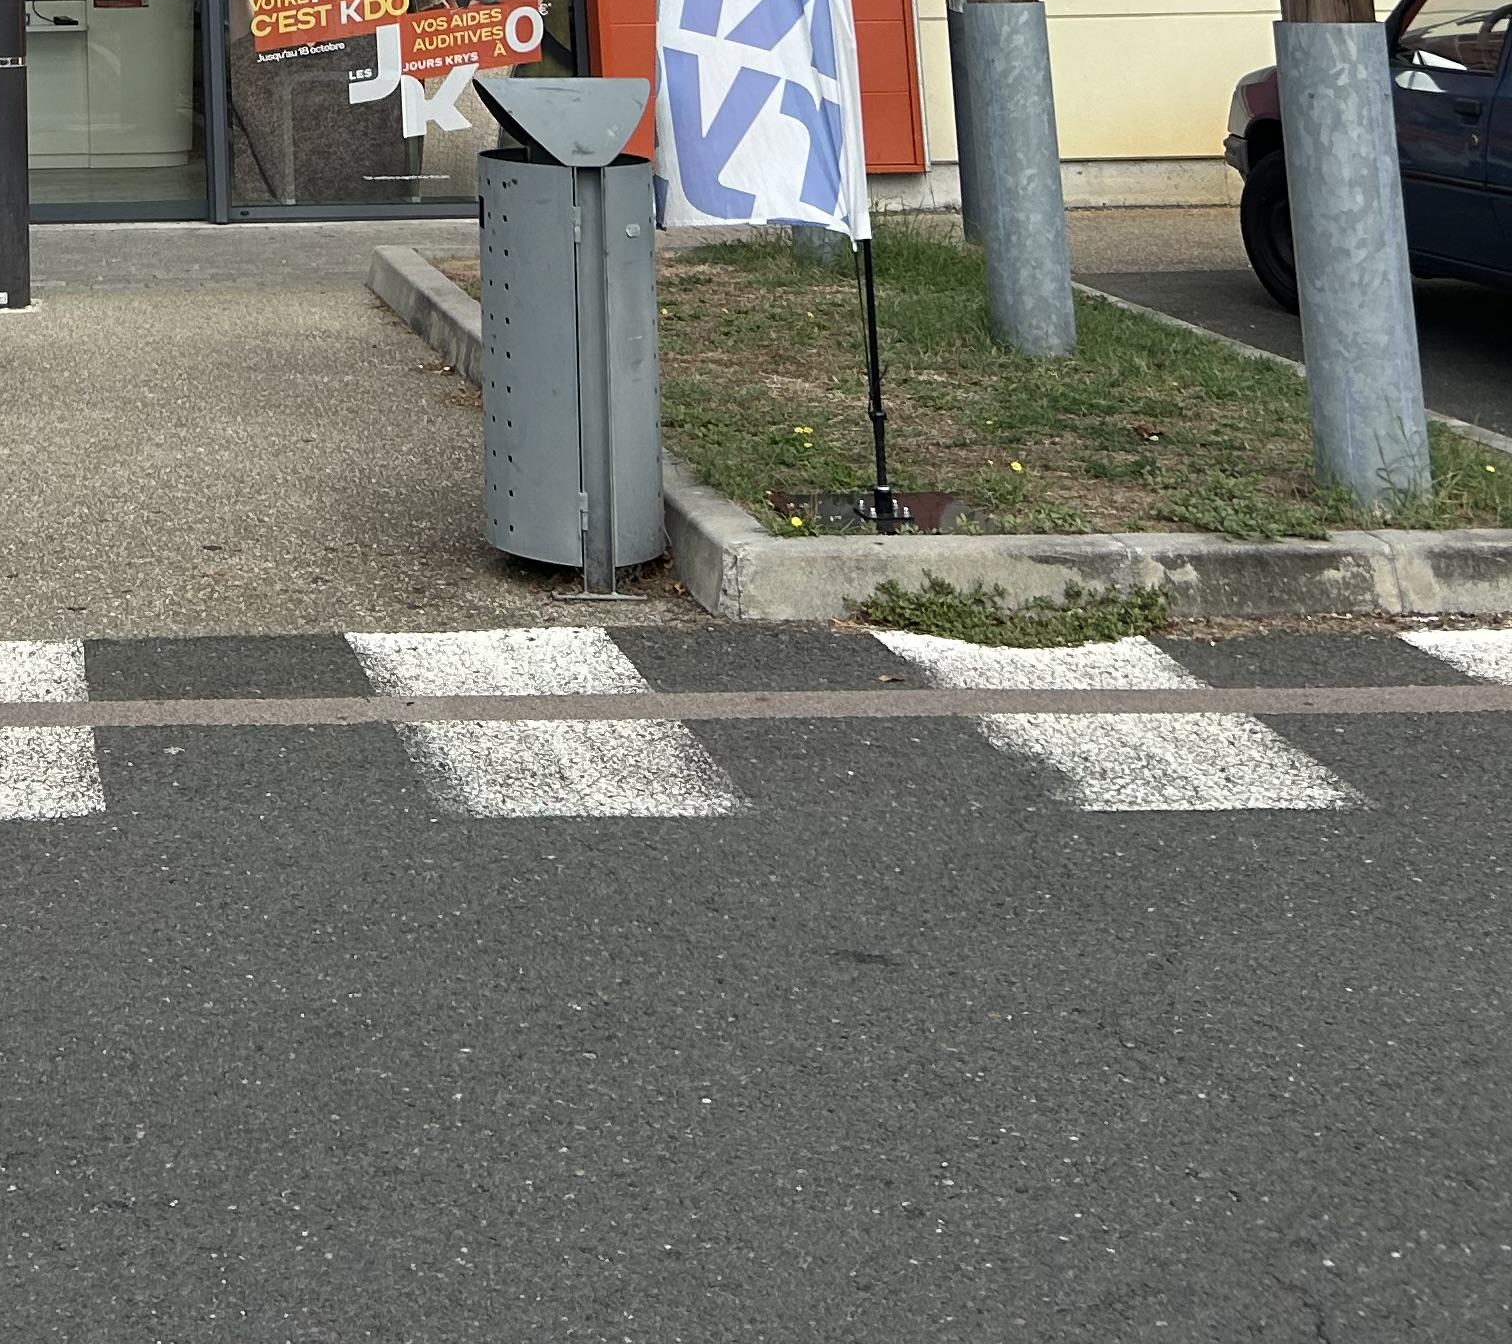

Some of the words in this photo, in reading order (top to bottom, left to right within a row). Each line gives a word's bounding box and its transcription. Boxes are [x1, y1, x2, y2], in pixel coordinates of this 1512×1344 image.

[250, 4, 332, 37] C'EST
[412, 18, 448, 33] VOS
[450, 8, 502, 29] AIDES
[413, 25, 504, 53] AUDITIVES
[493, 40, 507, 57] À
[256, 49, 299, 63] Jusqu'au
[310, 42, 345, 54] octobre
[348, 68, 373, 80] LES
[402, 56, 443, 72] JOURS
[444, 51, 480, 66] KRYS
